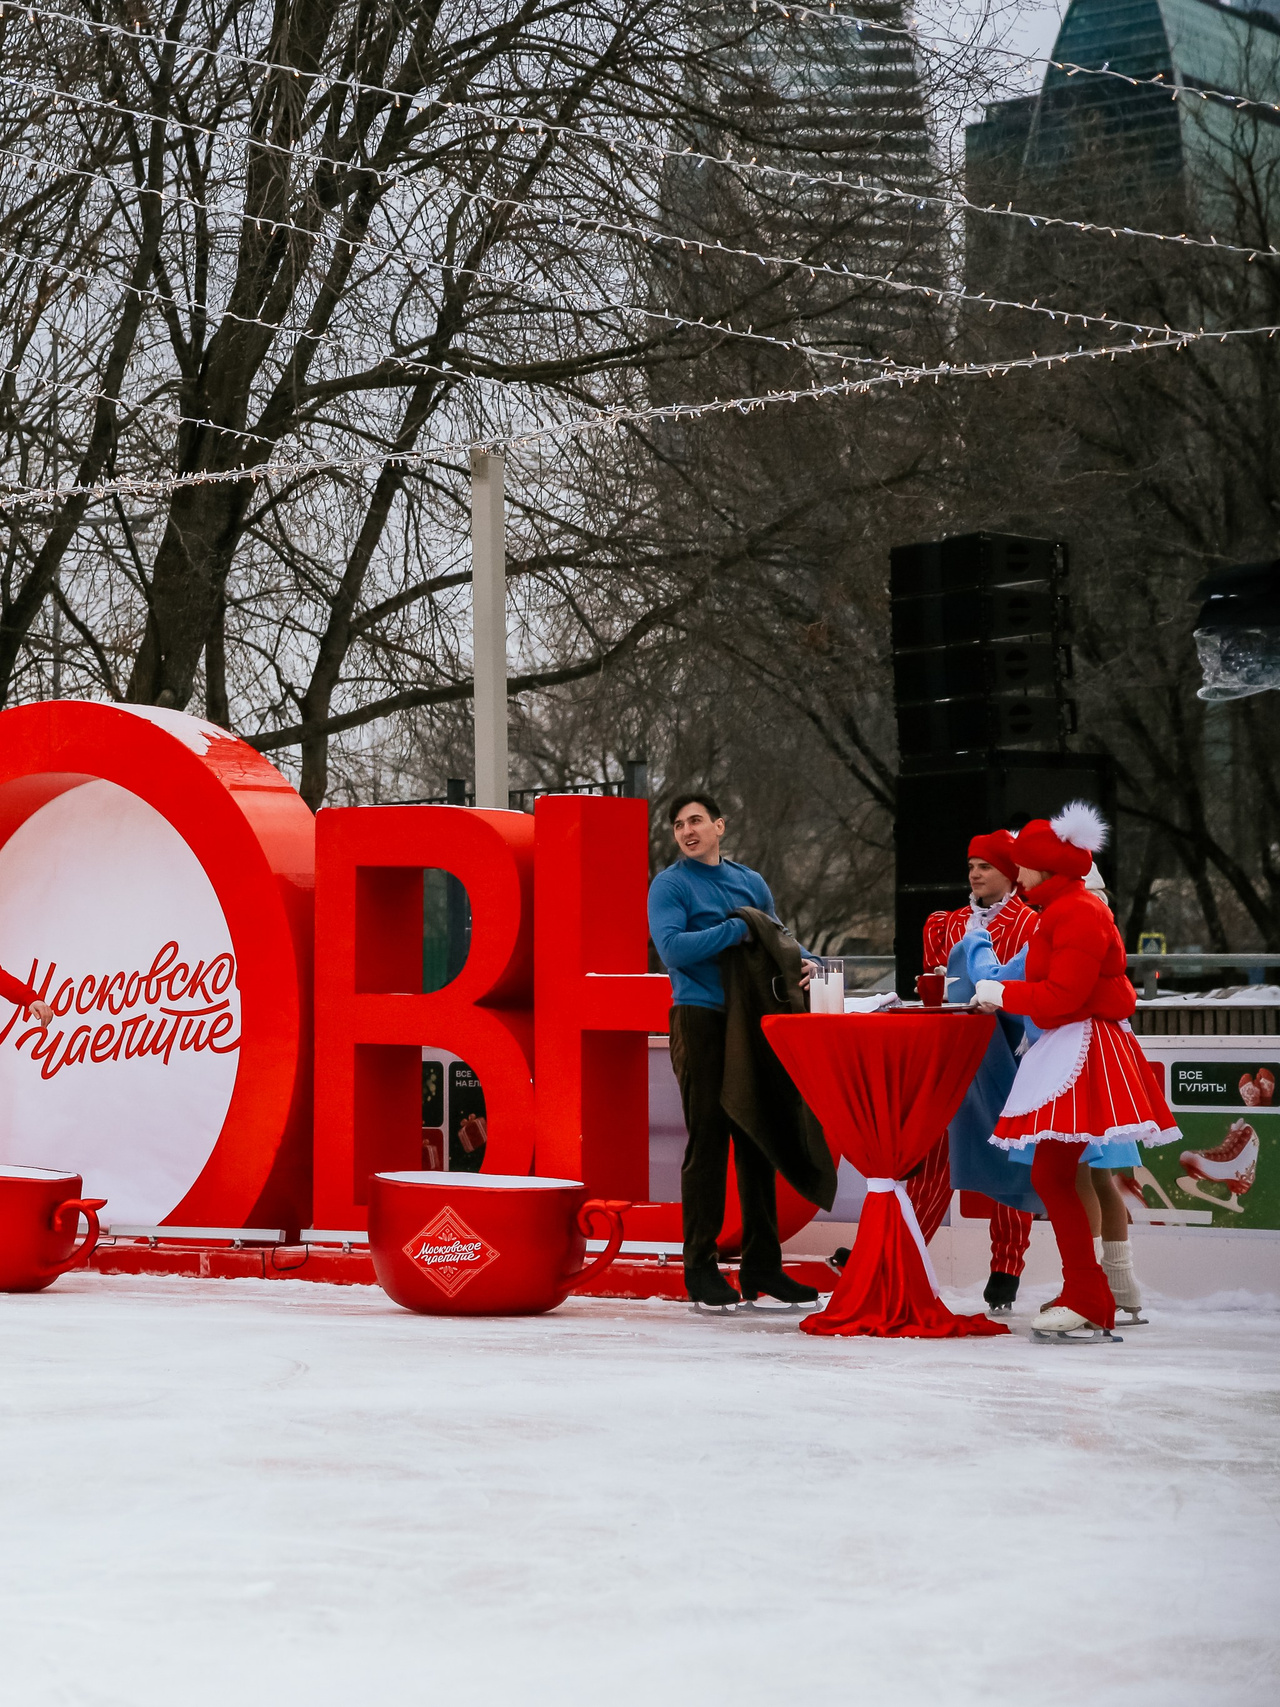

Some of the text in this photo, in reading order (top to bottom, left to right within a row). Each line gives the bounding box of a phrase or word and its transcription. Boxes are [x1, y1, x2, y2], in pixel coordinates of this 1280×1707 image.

[455, 1070, 472, 1078] ВСЕ
[1178, 1070, 1203, 1080] ВСЕ
[468, 1080, 482, 1088] ЕЛ
[1178, 1082, 1227, 1093] ГУЛЯТЬ!
[413, 1240, 482, 1260] Московское
